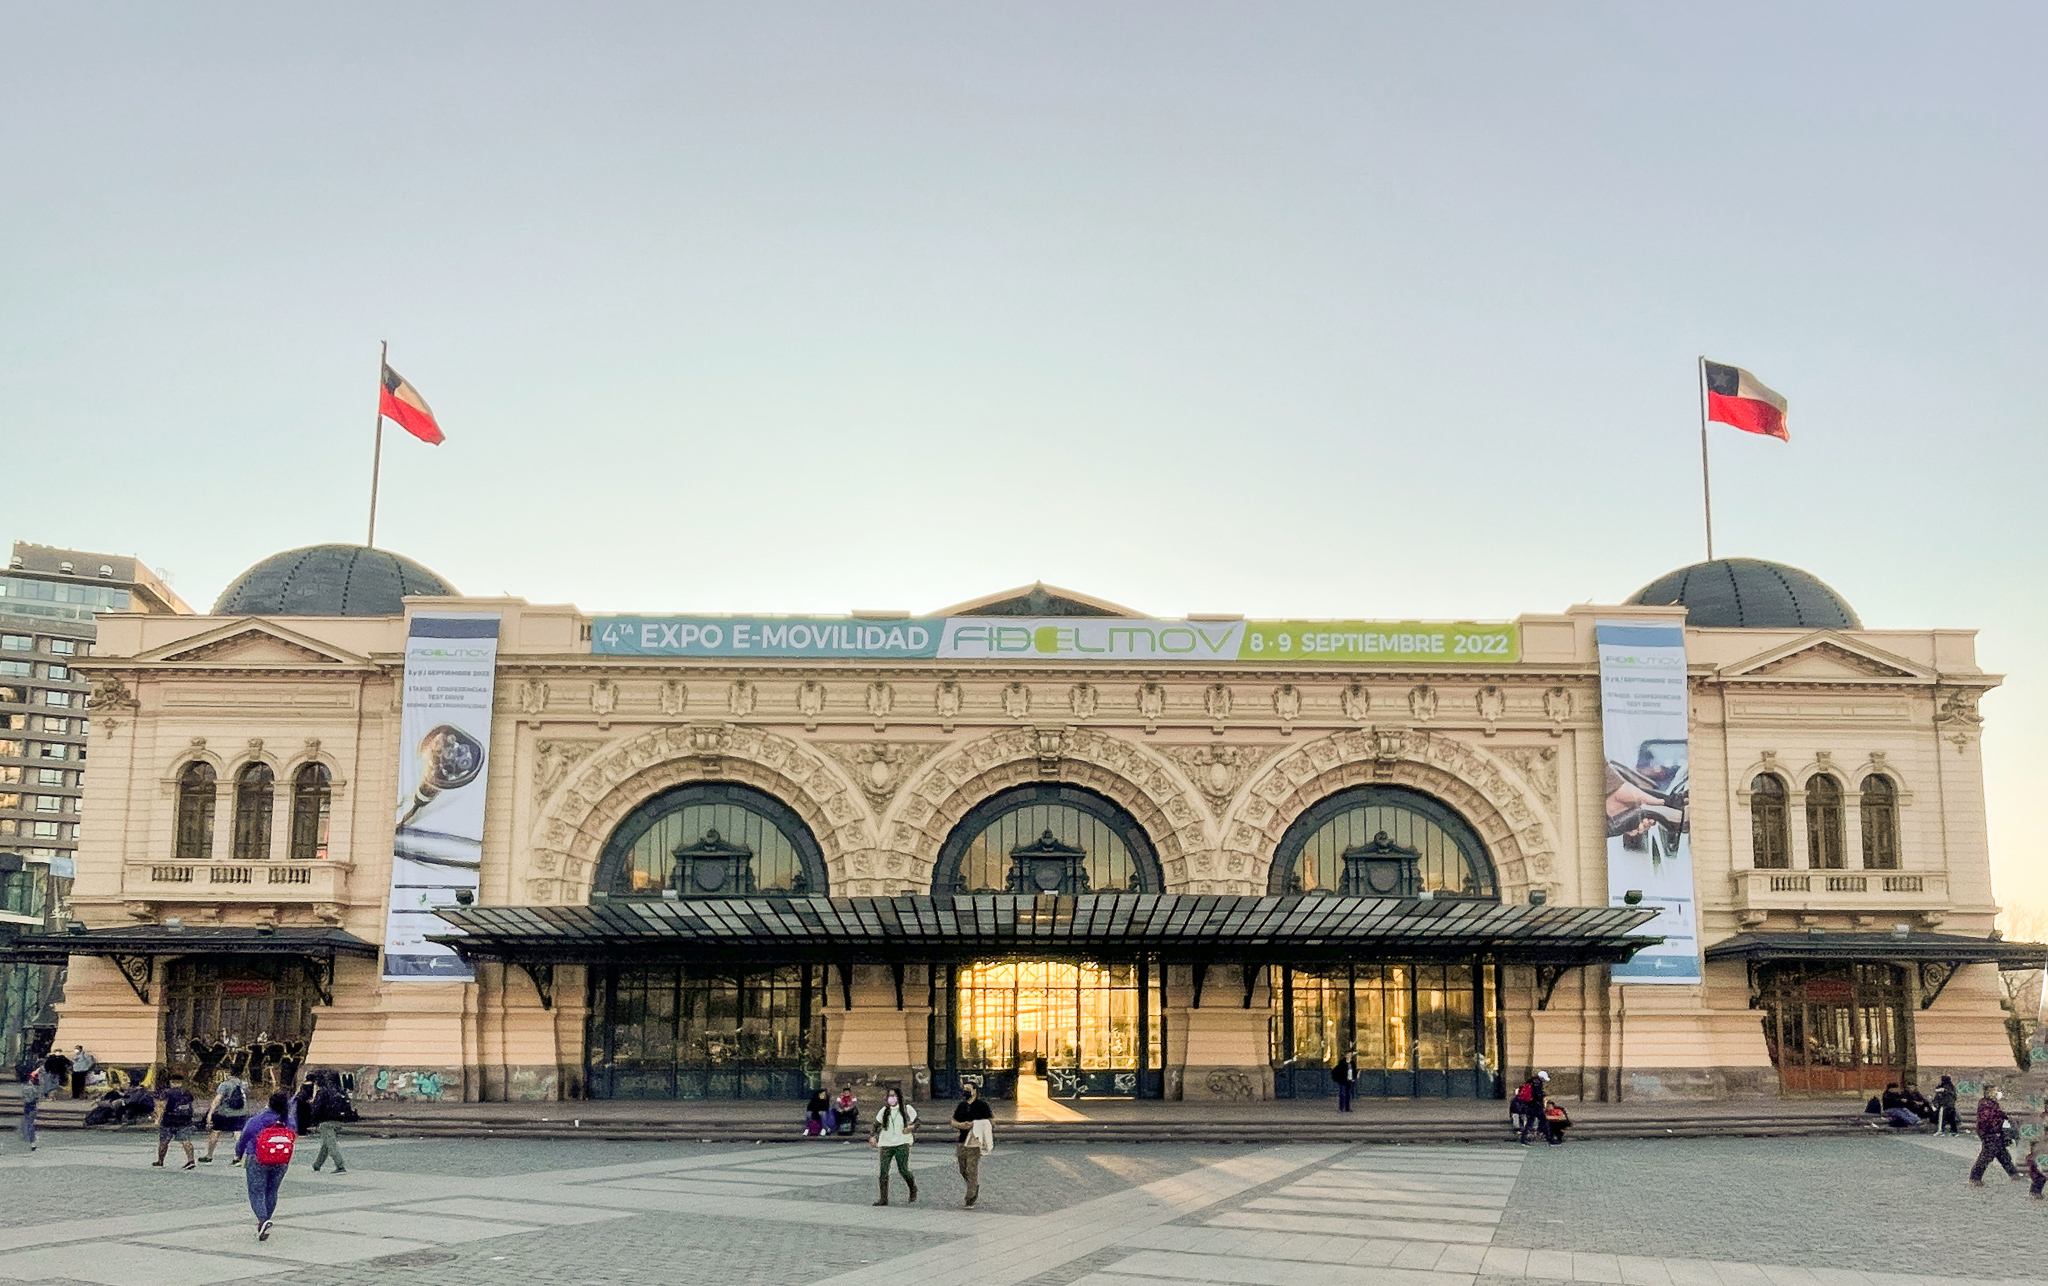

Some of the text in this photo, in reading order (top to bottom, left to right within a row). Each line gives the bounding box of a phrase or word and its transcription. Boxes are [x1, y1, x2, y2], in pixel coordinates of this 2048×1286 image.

[641, 623, 724, 649] EXPO
[732, 624, 930, 651] E-MOVILIDAD
[1301, 632, 1446, 653] SEPTIEMBRE
[1453, 634, 1509, 654] 2022
